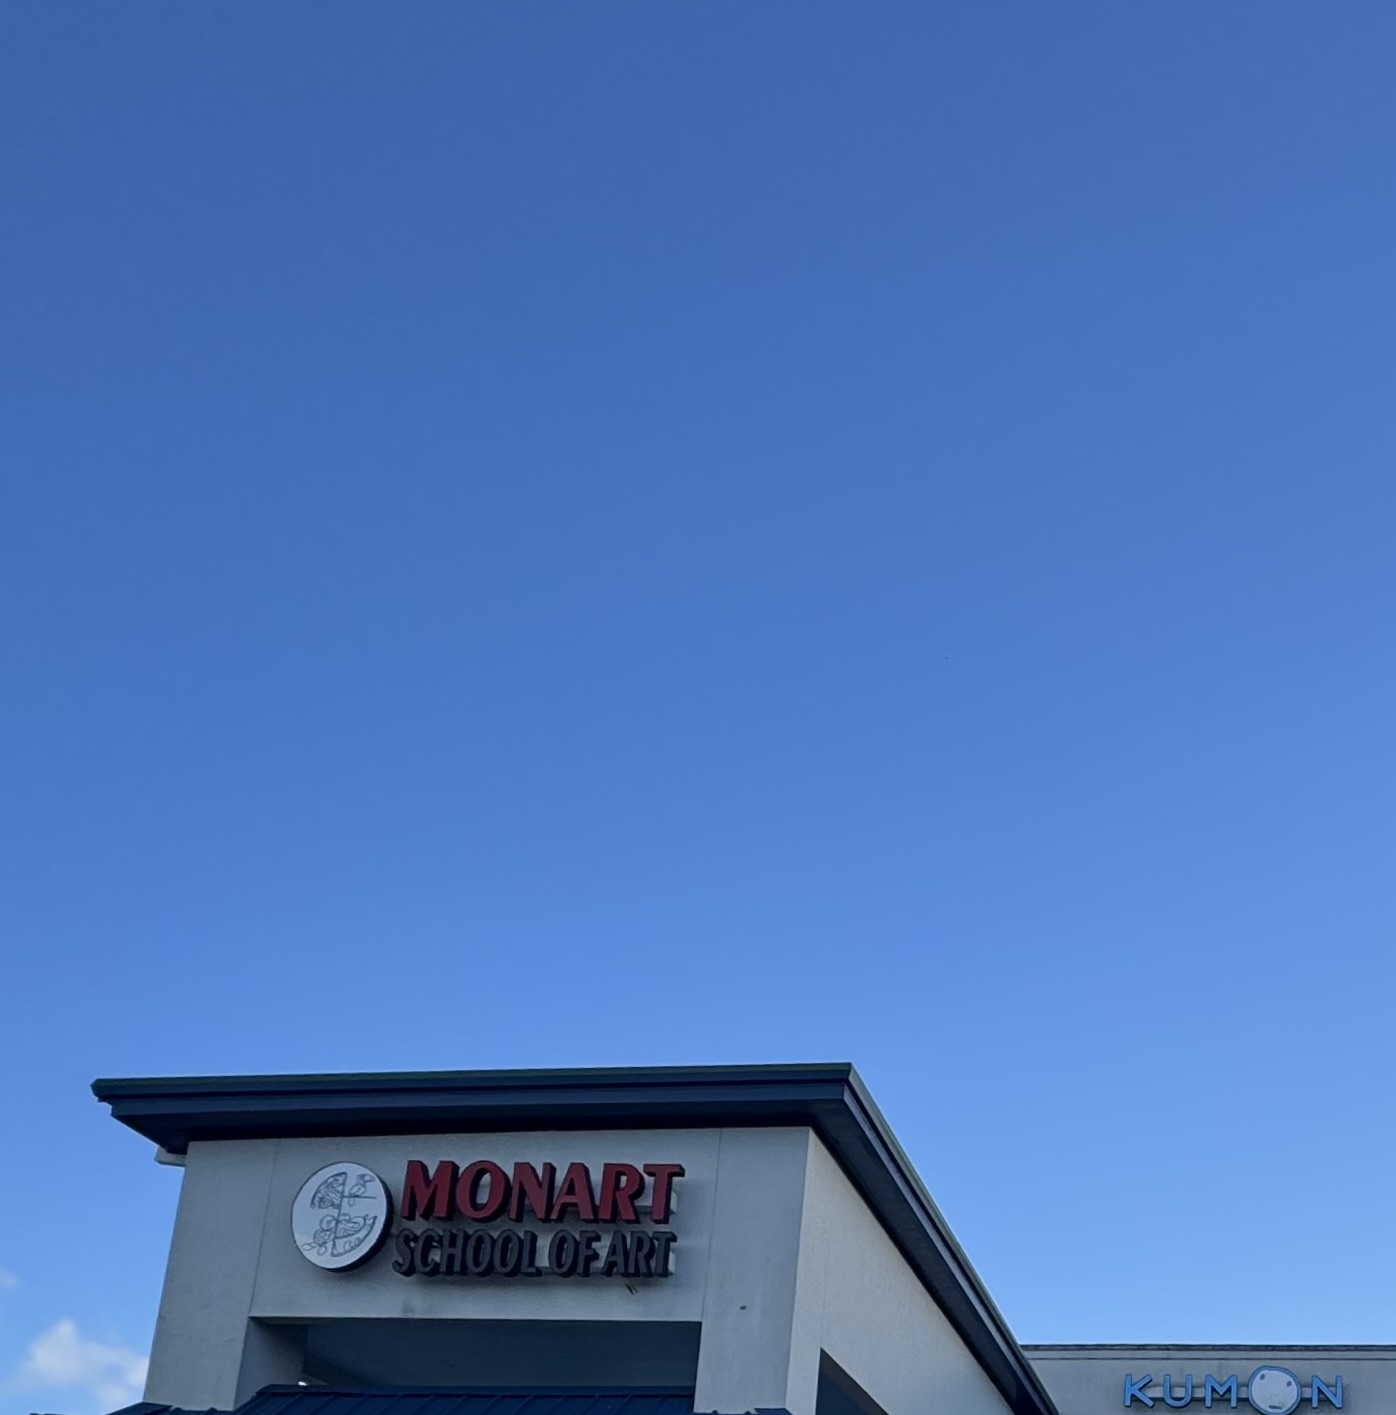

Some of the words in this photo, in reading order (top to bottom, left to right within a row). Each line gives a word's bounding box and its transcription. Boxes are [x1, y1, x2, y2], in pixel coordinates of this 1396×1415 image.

[401, 1159, 685, 1224] MONART
[392, 1228, 543, 1277] SCHOOL
[548, 1229, 601, 1277] OF
[602, 1230, 677, 1277] ART
